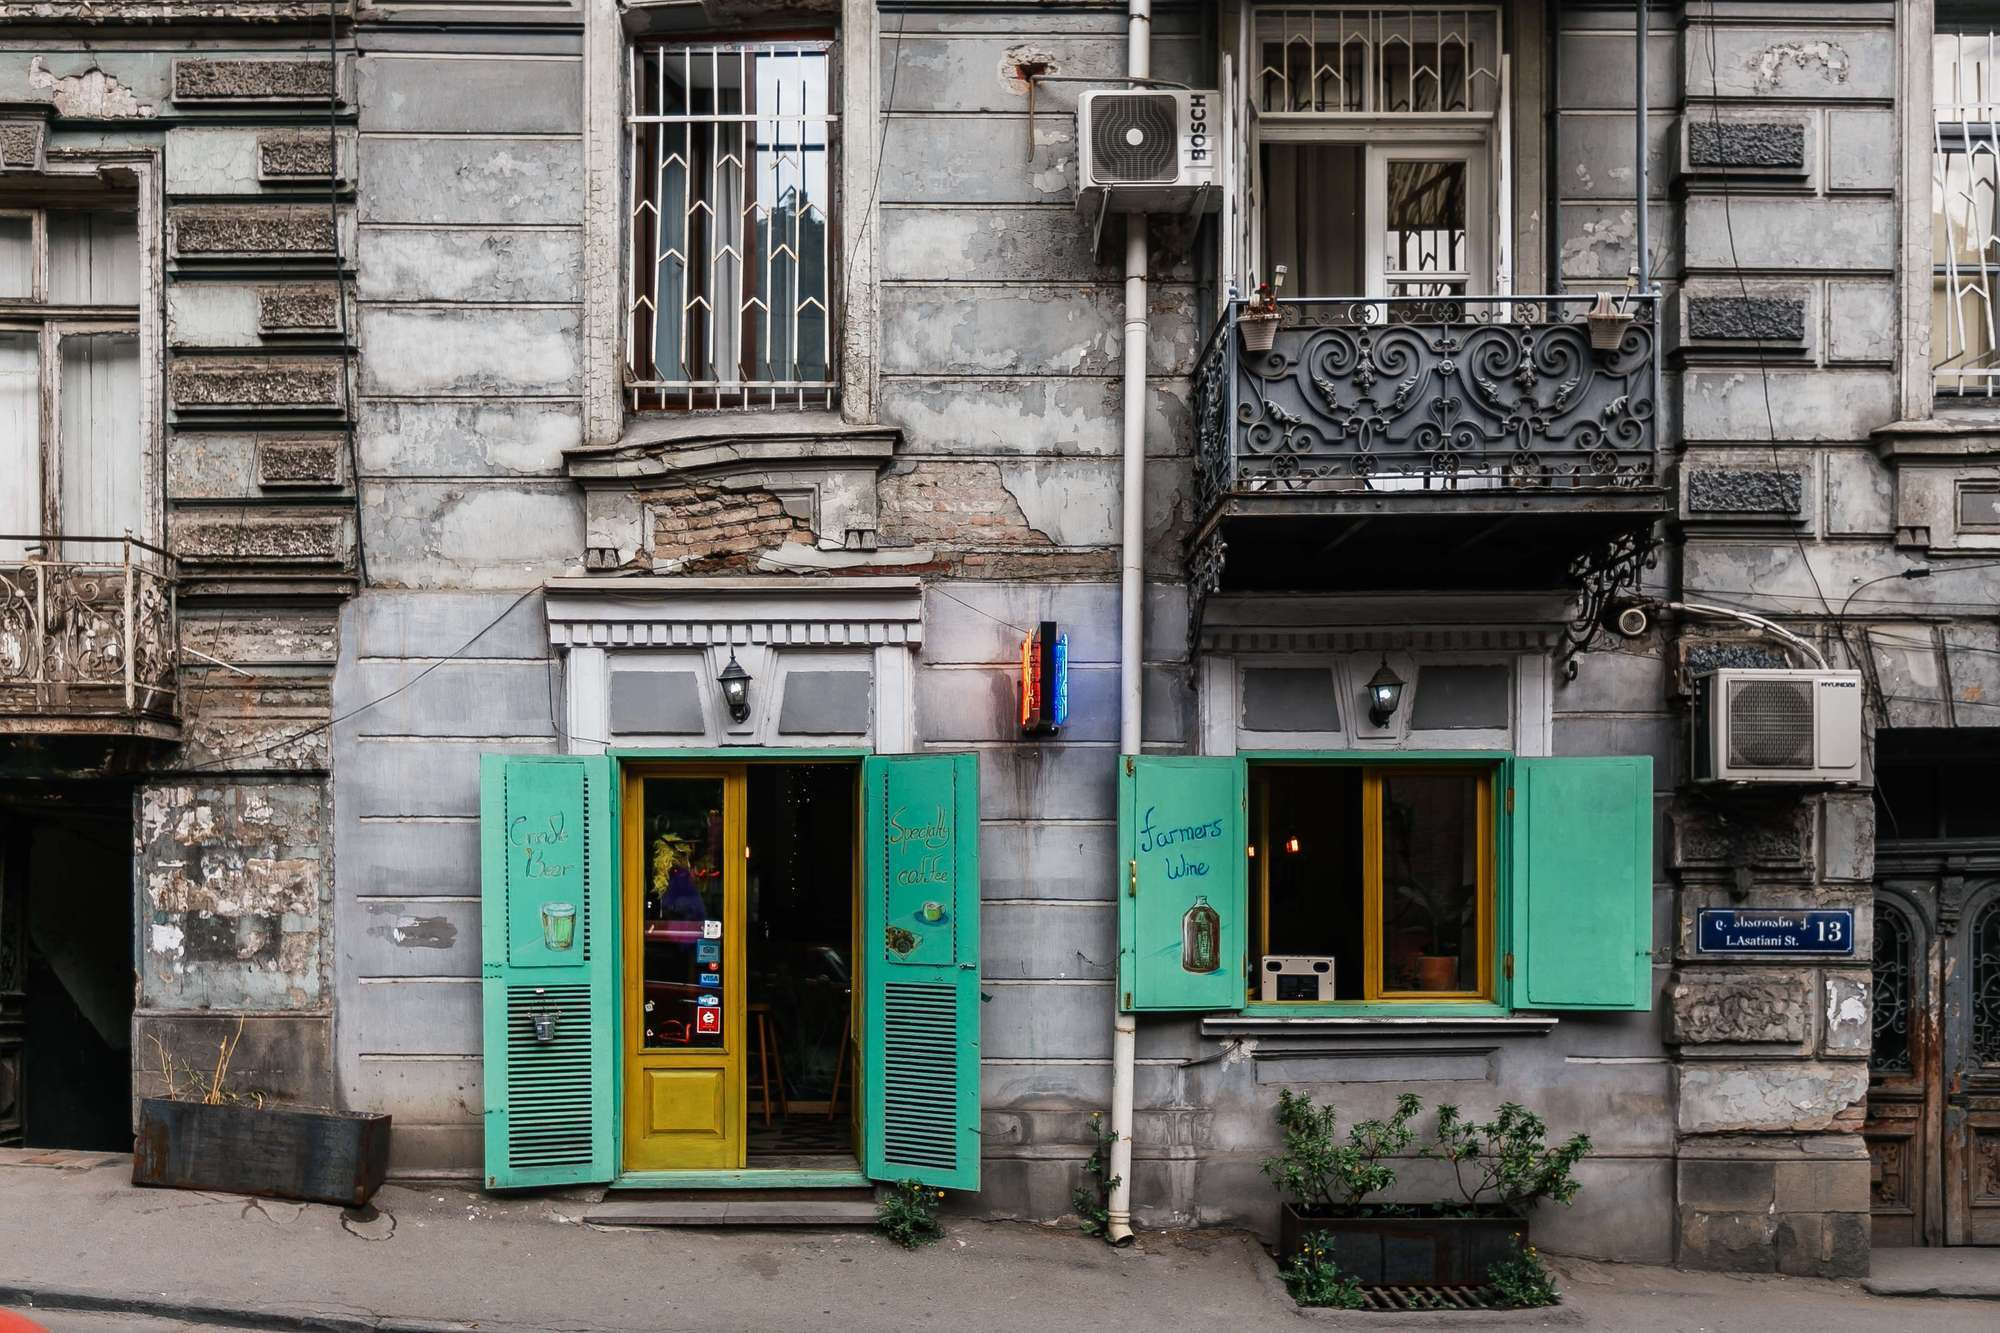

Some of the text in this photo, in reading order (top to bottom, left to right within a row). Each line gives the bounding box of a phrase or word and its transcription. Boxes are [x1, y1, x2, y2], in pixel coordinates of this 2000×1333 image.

[1190, 94, 1206, 161] BOSCH
[890, 805, 950, 855] Specialty
[1165, 854, 1210, 880] Wine
[1726, 934, 1799, 946] L.Asatiani St.
[1816, 921, 1842, 942] 13
